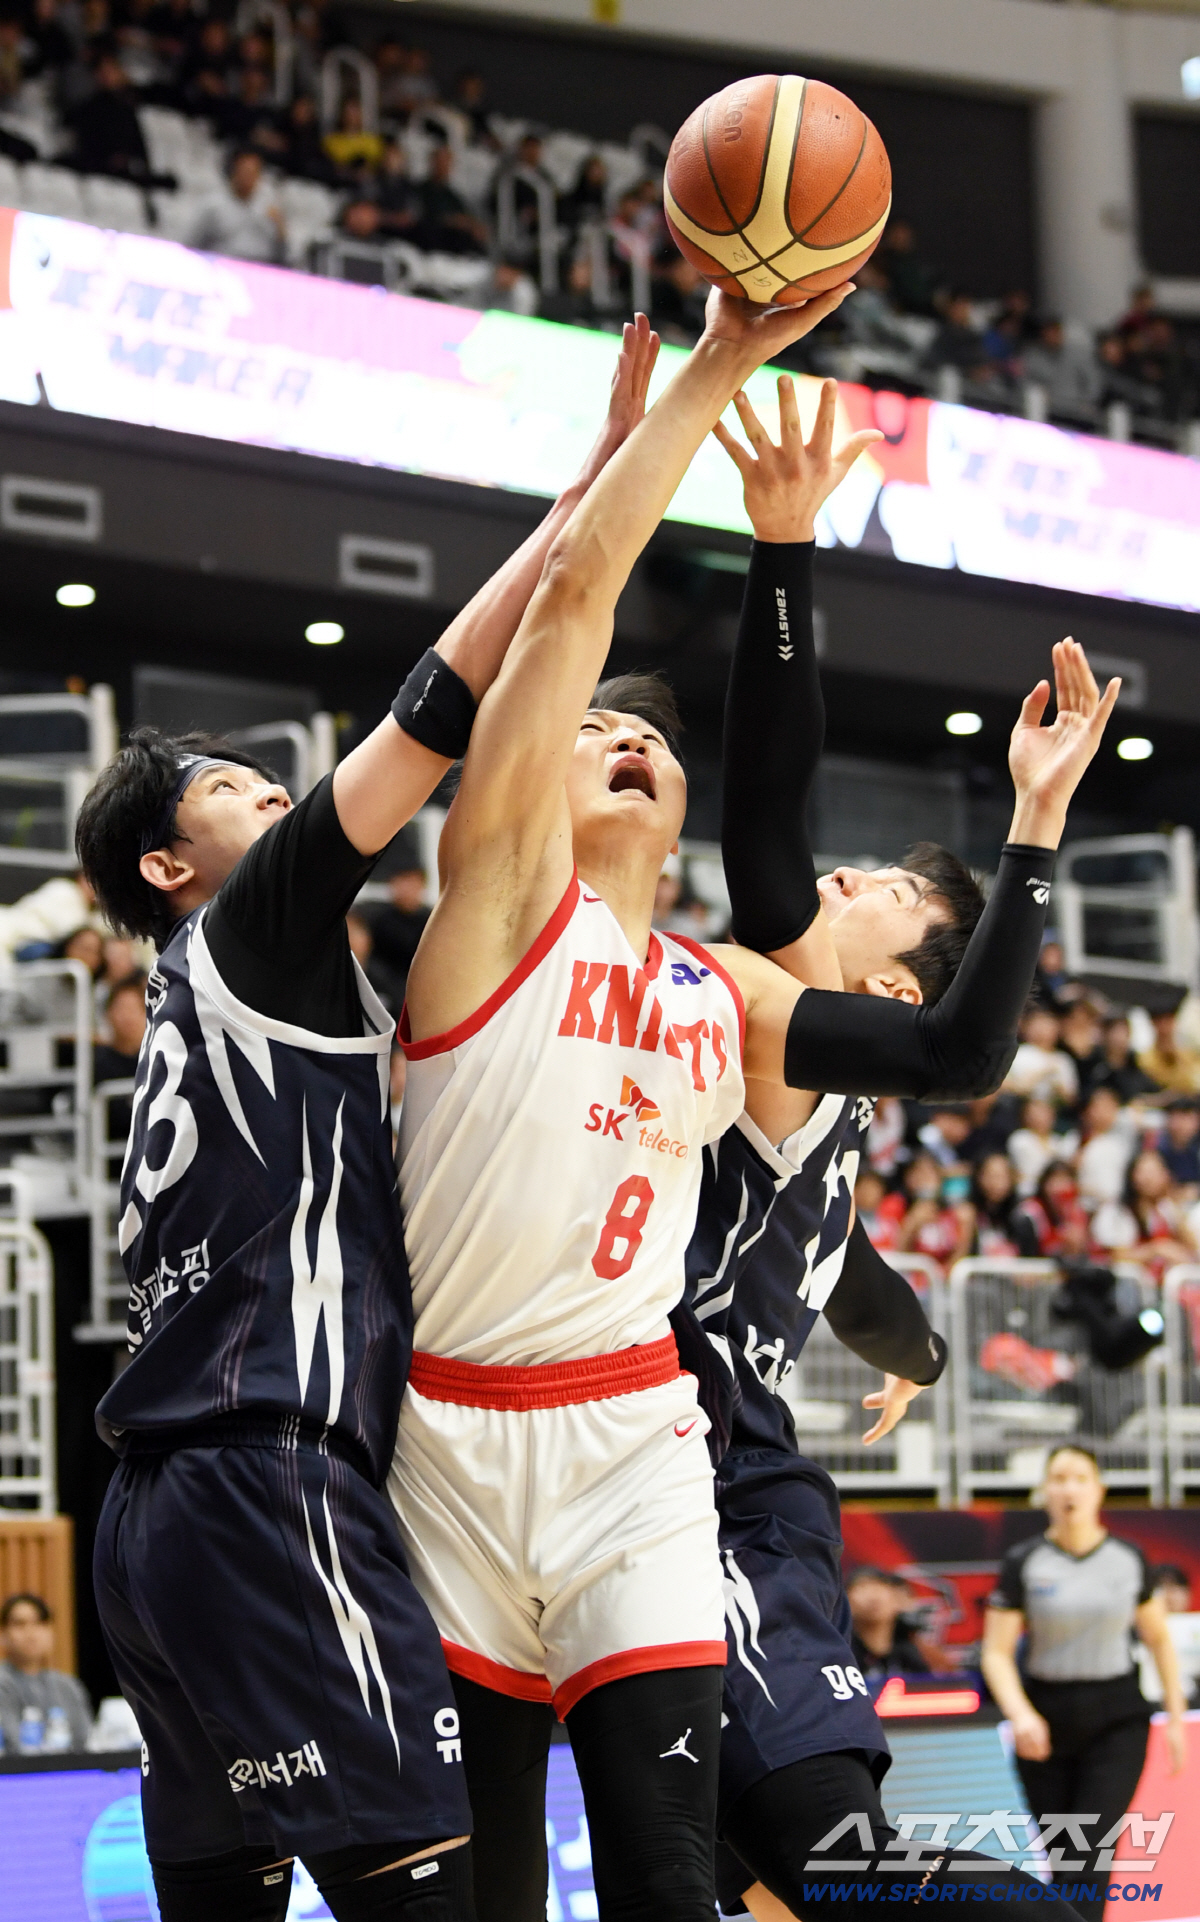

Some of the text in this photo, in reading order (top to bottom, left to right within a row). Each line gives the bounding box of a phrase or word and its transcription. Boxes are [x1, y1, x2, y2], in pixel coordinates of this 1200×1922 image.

[558, 959, 728, 1093] KNITS
[584, 1103, 630, 1141] SK
[639, 1126, 689, 1160] teleco
[591, 1174, 655, 1280] 8
